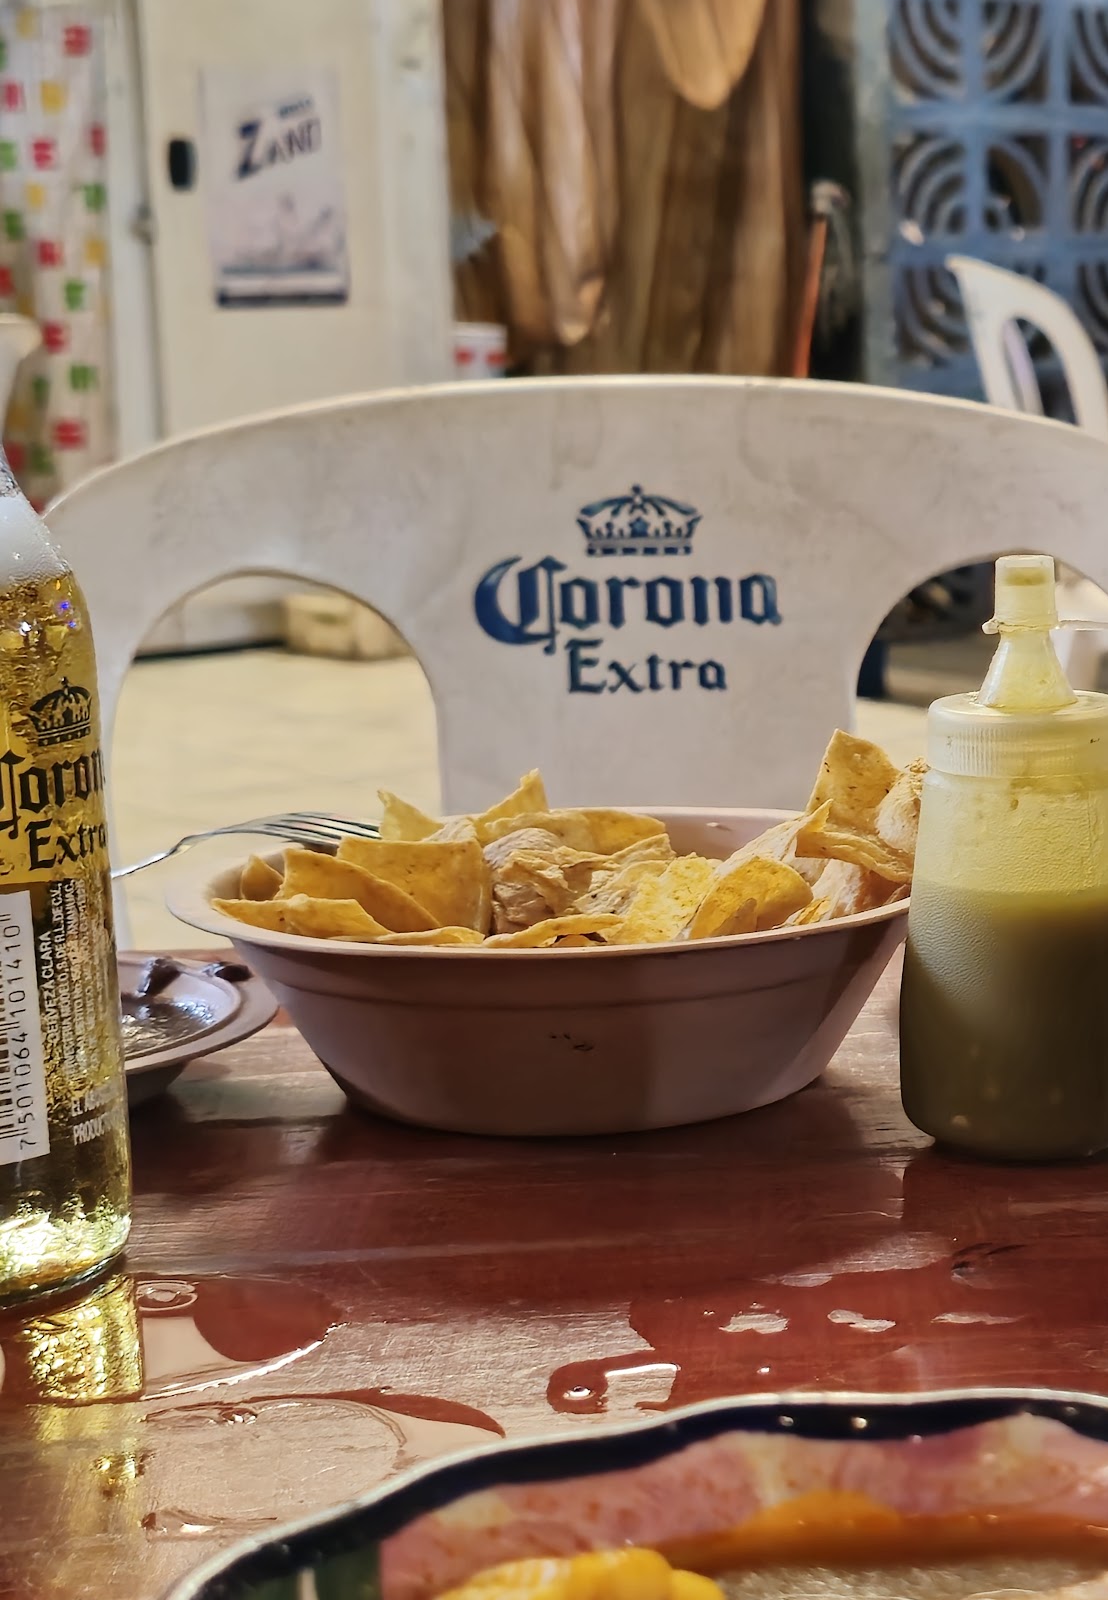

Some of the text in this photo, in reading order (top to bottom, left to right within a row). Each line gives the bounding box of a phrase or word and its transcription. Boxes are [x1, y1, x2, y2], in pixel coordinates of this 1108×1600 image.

[473, 555, 783, 656] Corona
[564, 637, 728, 694] Extra
[0, 748, 105, 840] oron
[3, 925, 26, 1020] 101410
[38, 931, 60, 1043] CERVEZA CLARA
[12, 1032, 35, 1125] 501064
